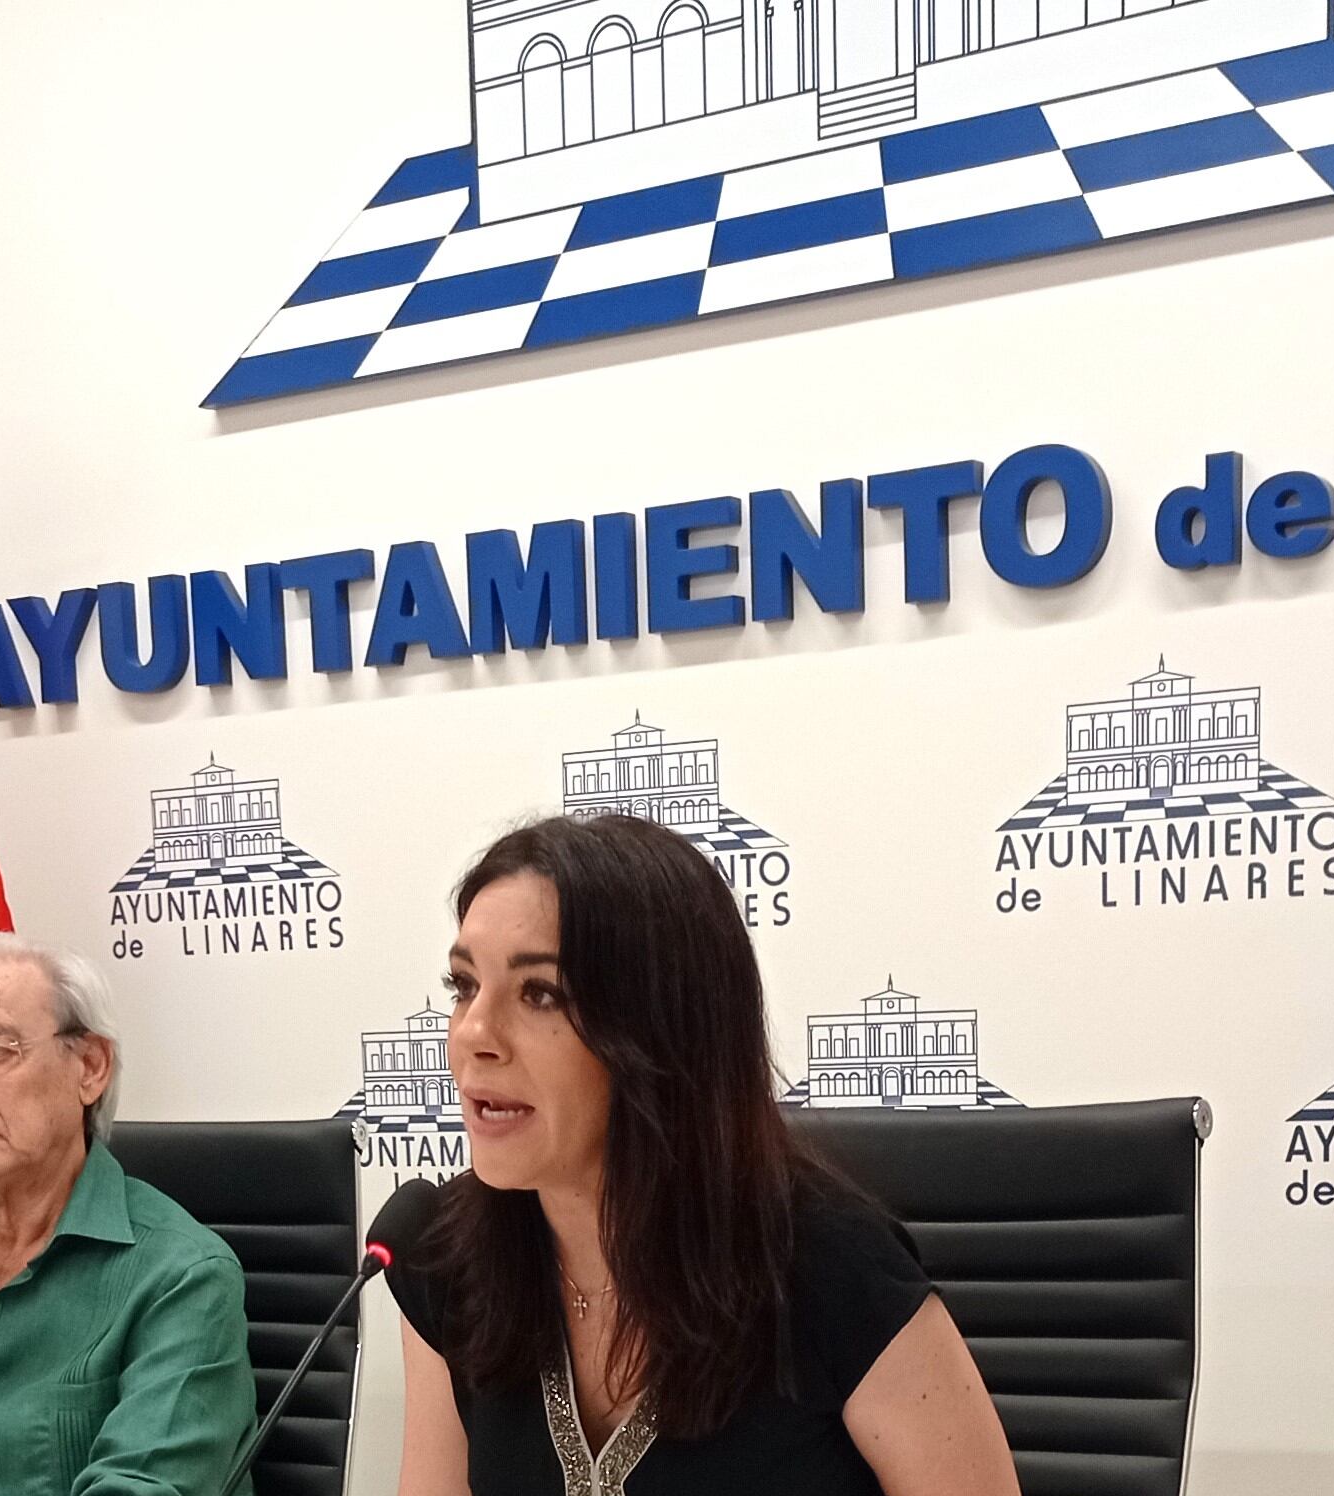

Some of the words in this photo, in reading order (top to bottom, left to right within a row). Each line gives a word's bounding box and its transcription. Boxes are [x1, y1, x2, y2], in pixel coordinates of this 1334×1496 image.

[110, 880, 342, 926] AYUNTAMIENTO
[997, 877, 1041, 912] de
[112, 928, 144, 960] de
[183, 916, 344, 956] LINARES
